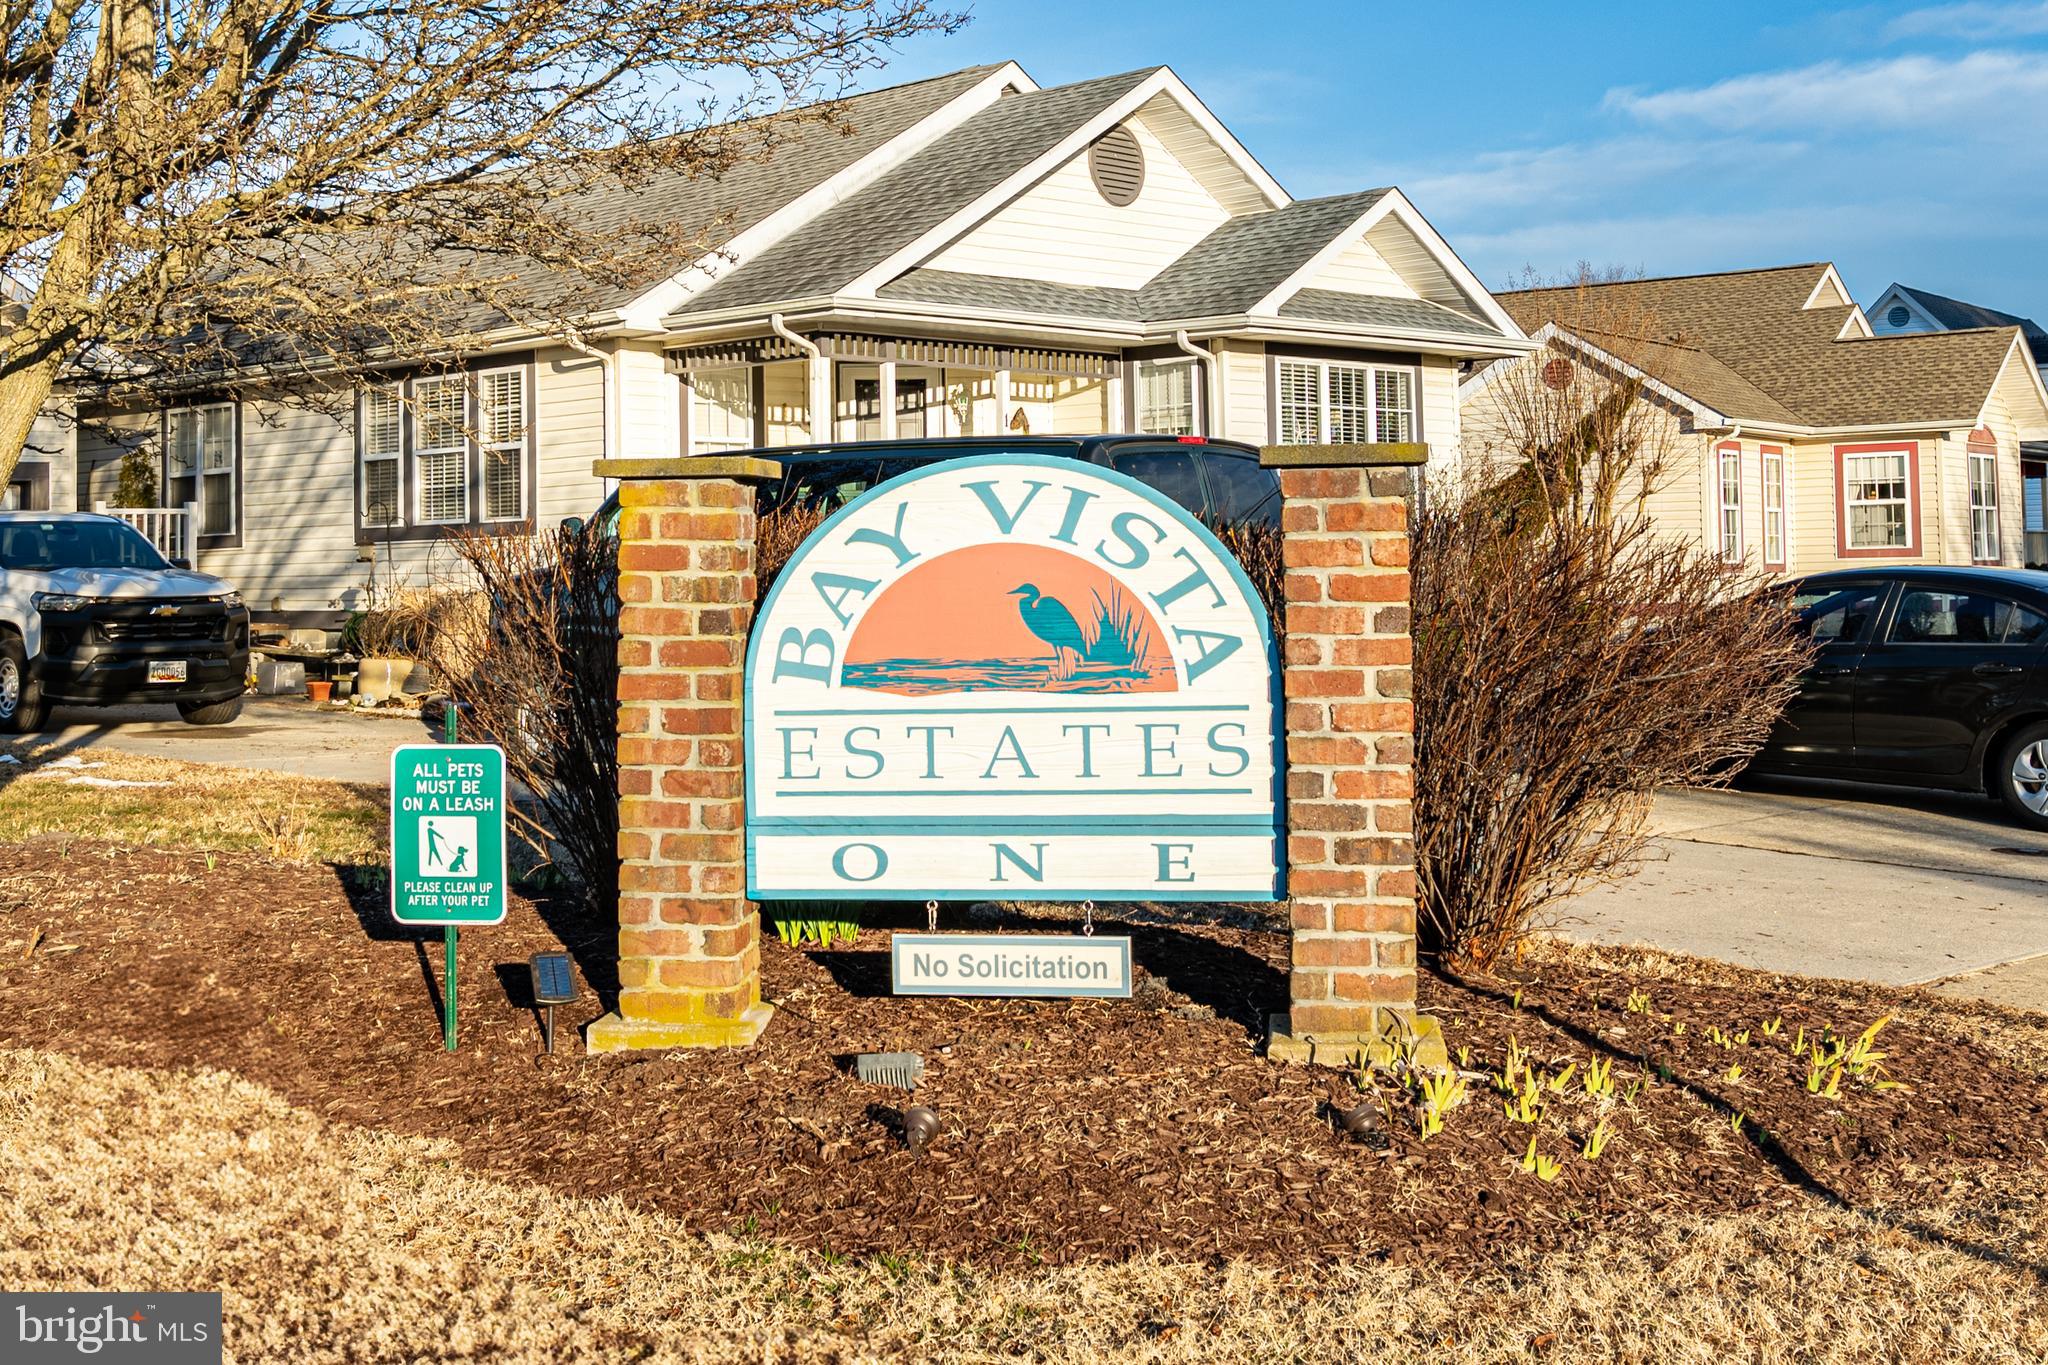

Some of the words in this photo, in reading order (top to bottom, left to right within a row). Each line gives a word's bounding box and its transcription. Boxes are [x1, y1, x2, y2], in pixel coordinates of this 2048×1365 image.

[772, 502, 921, 688] BAY
[960, 480, 1243, 686] VISTA
[775, 722, 1250, 780] ESTATES
[413, 764, 442, 777] ALL
[448, 764, 483, 777] PETS
[416, 781, 455, 794] MUST
[462, 781, 480, 794] BE
[402, 797, 423, 811] ON
[429, 798, 440, 811] A
[446, 798, 494, 811] LEASH
[832, 842, 1195, 883] ONE
[404, 882, 441, 893] PLEASE
[444, 882, 475, 893] CLEAN
[479, 882, 493, 893] UP
[408, 895, 438, 906] AFTER
[441, 895, 468, 906] YOUR
[471, 895, 490, 906] PET
[913, 953, 949, 978] No
[958, 953, 1108, 980] Solicitation
